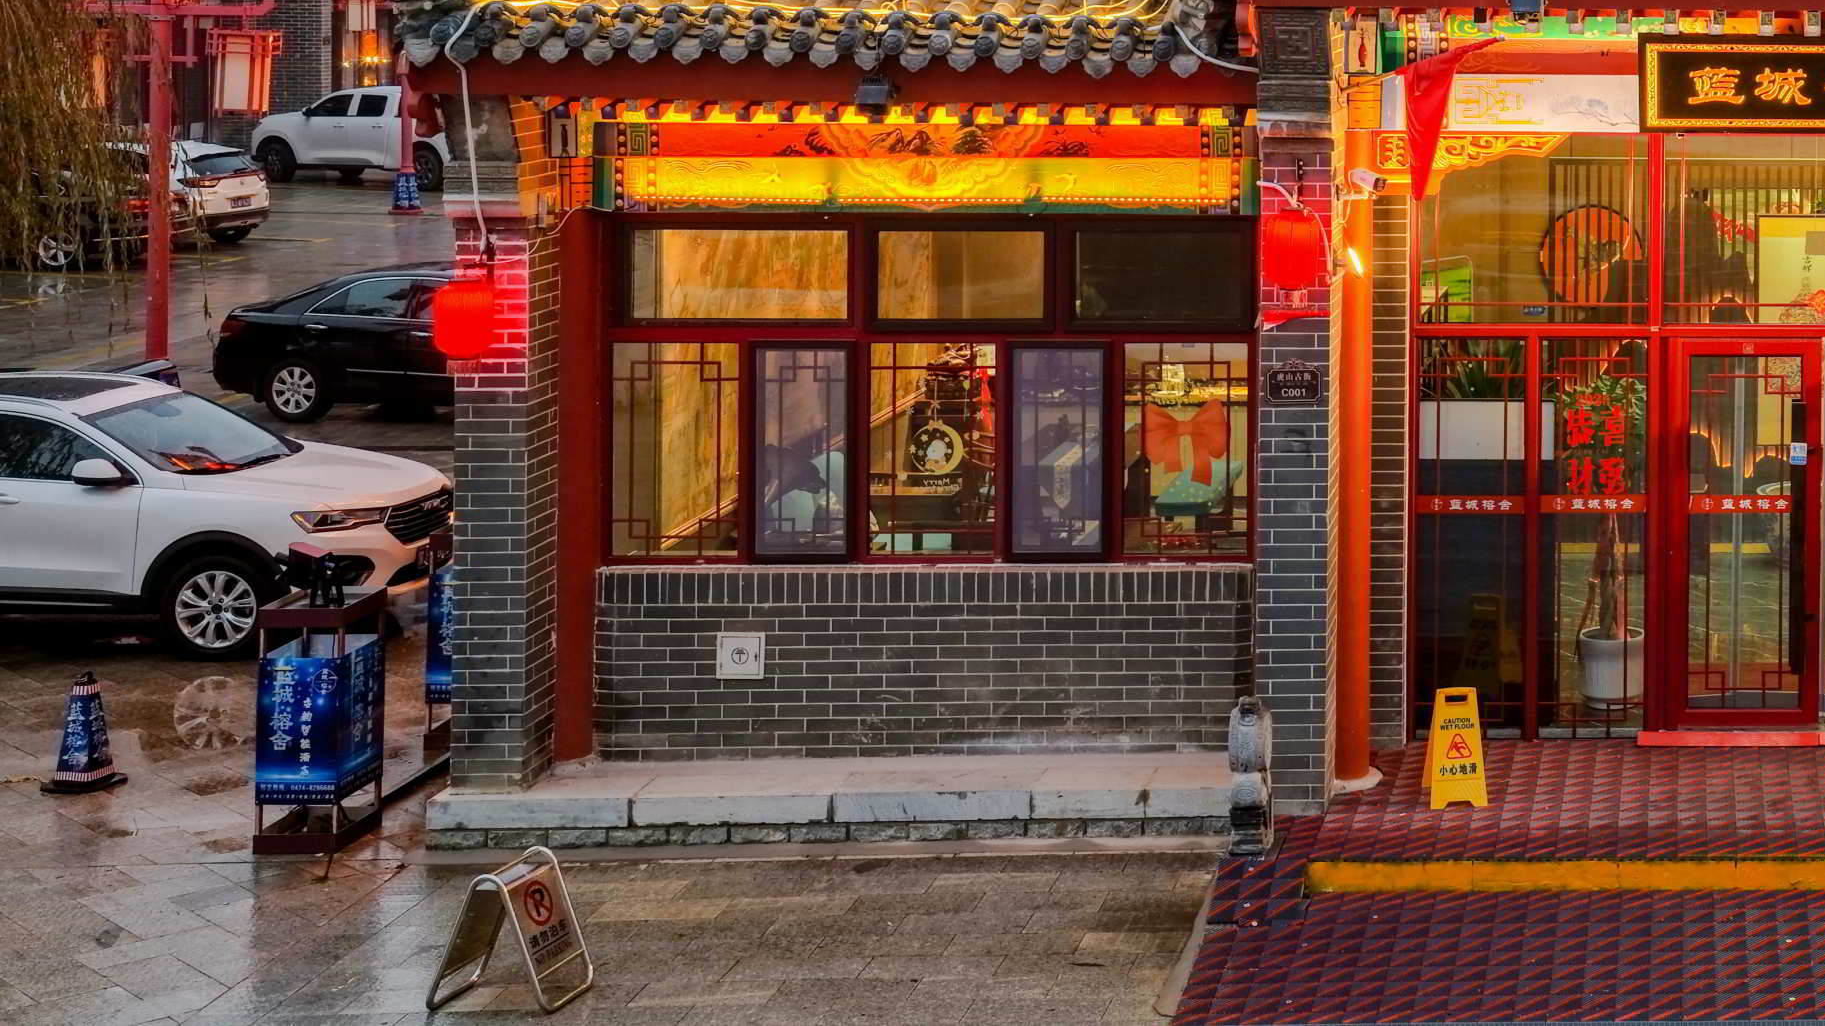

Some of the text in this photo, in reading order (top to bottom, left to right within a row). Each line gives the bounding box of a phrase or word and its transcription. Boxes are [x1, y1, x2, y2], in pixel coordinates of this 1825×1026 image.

[1281, 388, 1306, 397] C001
[1439, 762, 1477, 776] 小心地滑
[529, 918, 568, 949] 请勿泊车
